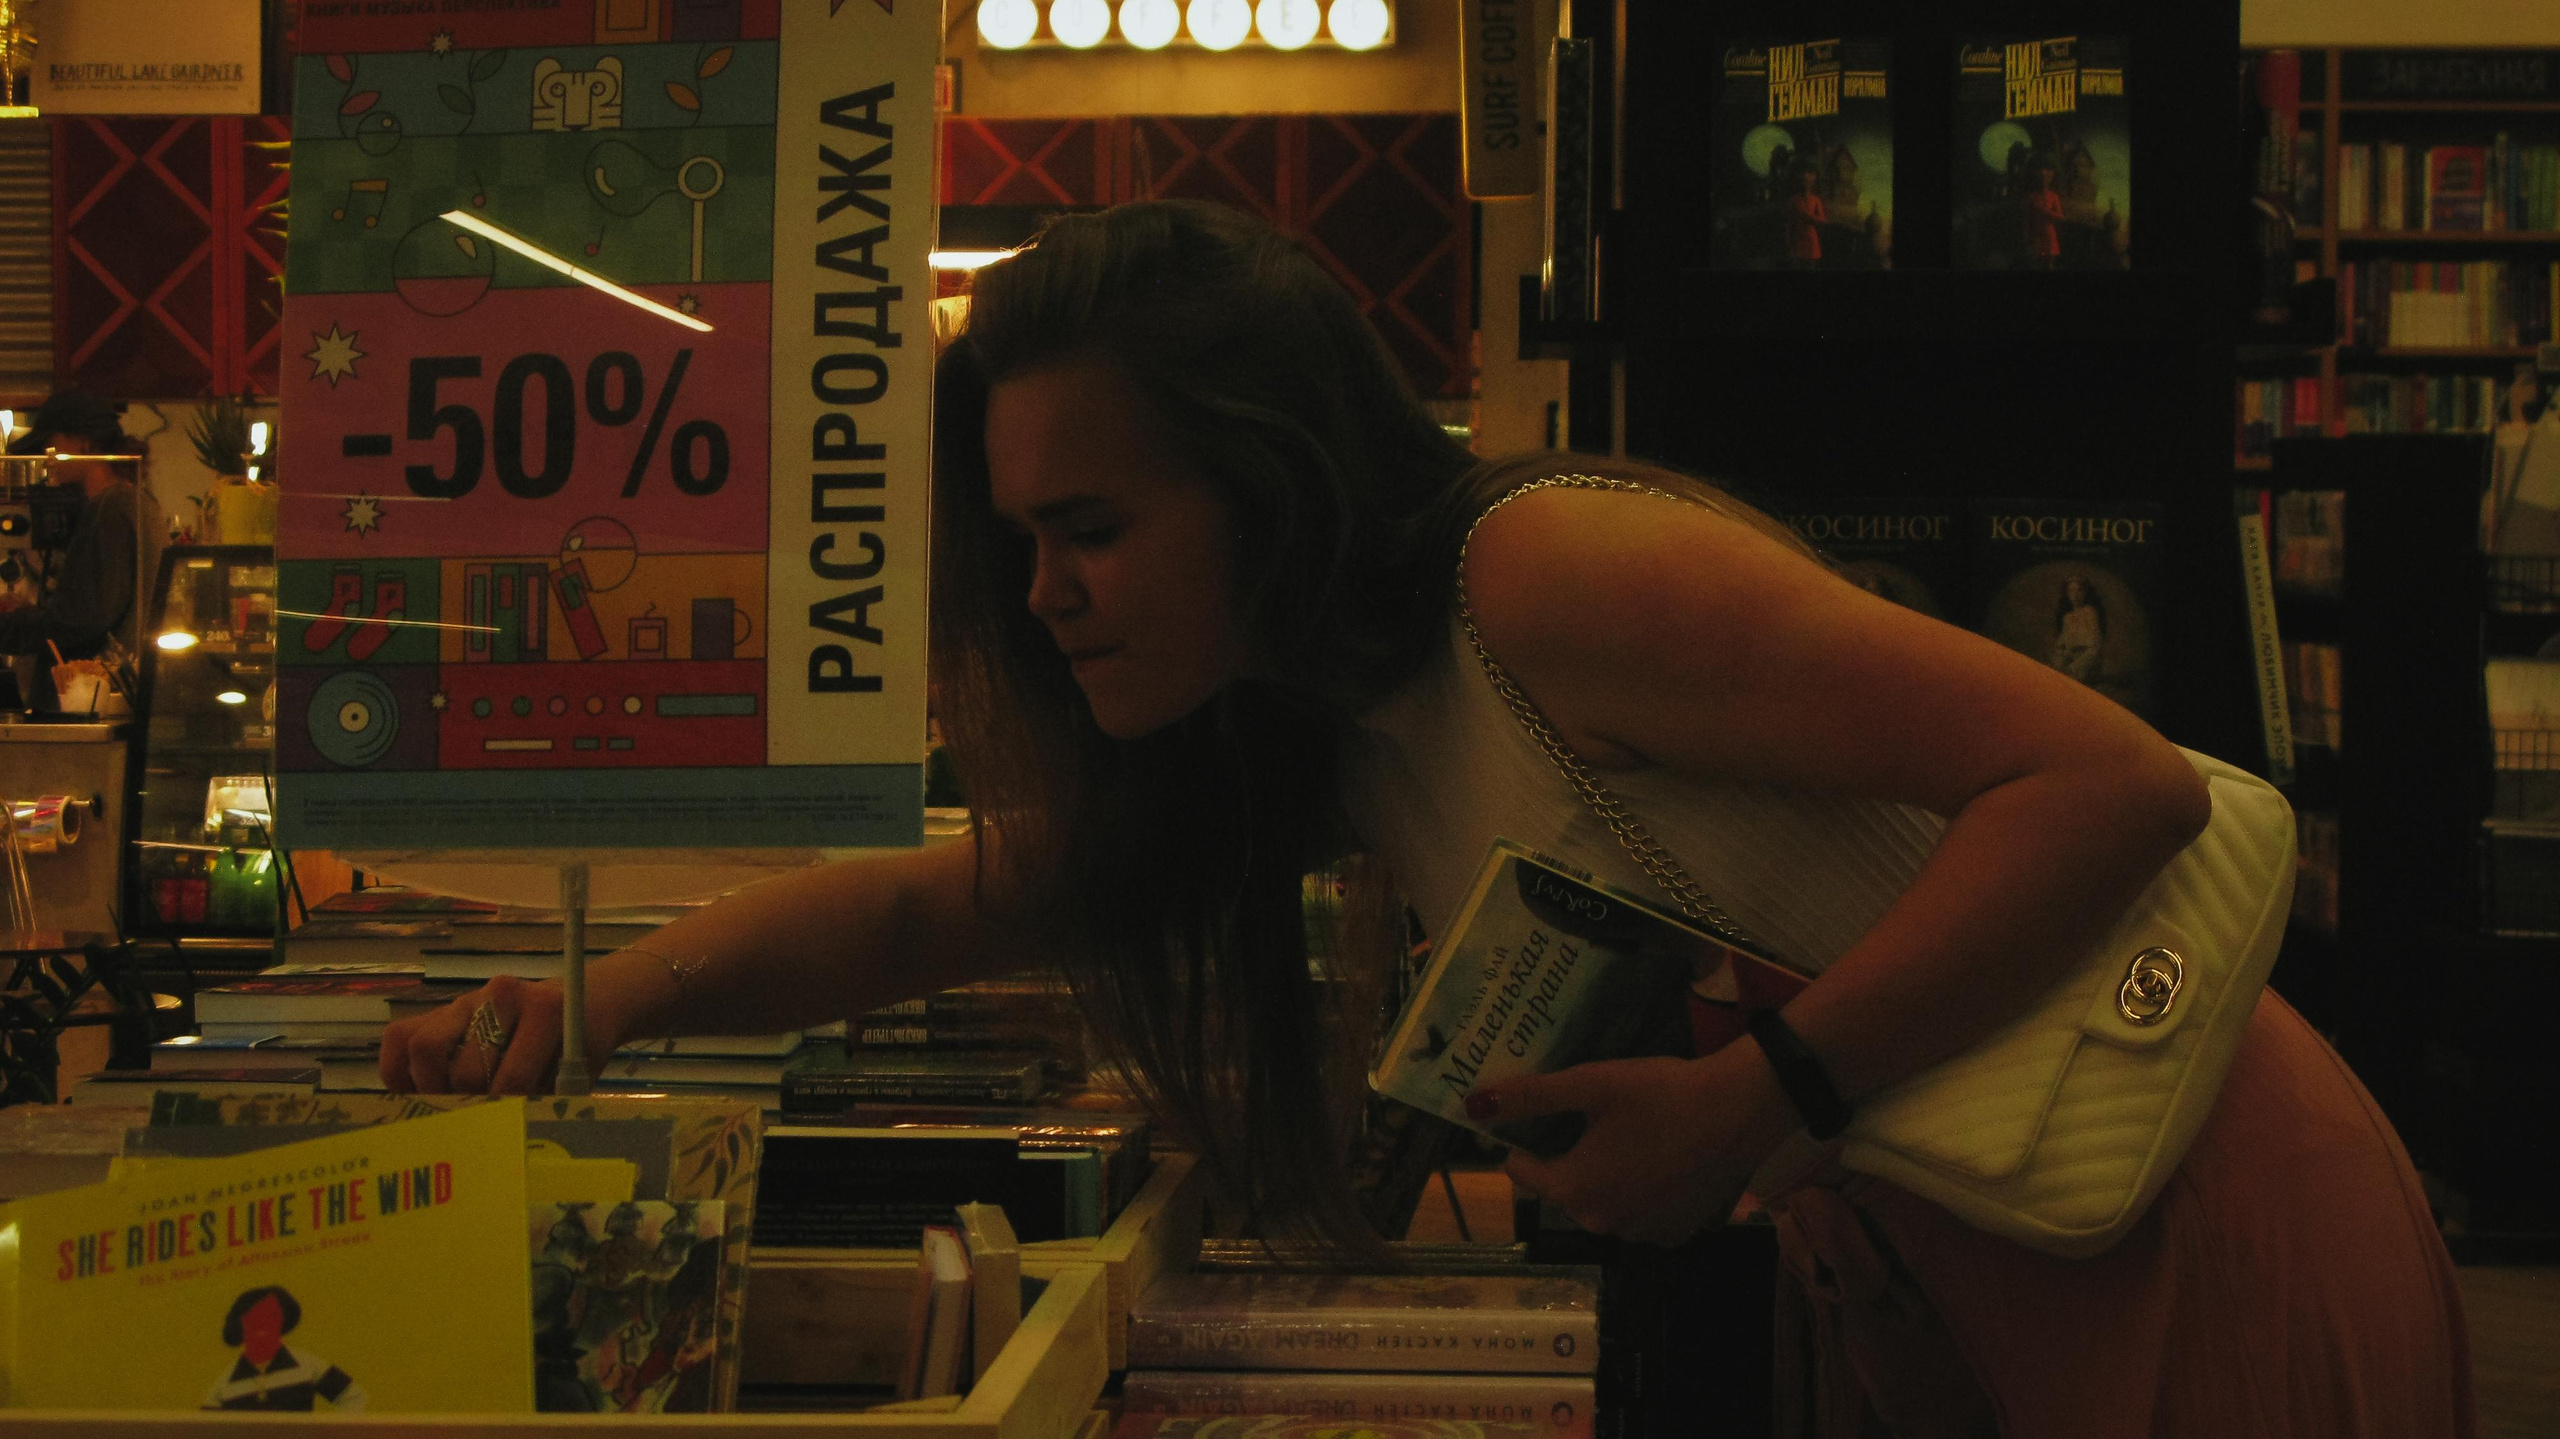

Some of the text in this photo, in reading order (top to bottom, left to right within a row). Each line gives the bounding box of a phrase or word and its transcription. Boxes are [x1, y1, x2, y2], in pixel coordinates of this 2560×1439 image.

[366, 1, 436, 15] МУЗЫКА
[50, 63, 126, 81] BEAUTIFUL
[132, 63, 167, 81] LAKE
[1768, 43, 1806, 84] НИЛ
[2005, 41, 2042, 82] НИЛ
[1483, 72, 1519, 149] SURF
[808, 82, 902, 693] РАСПРОДАЖА
[342, 348, 730, 499] -50%
[1786, 514, 1950, 541] КОСИНОГ
[1989, 514, 2154, 544] КОСИНОГ
[2261, 632, 2281, 719] ЛЮБИМЧИК
[1456, 945, 1510, 1031] ГАЭЛЬ ФАЙ
[1507, 942, 1580, 1059] страна
[1439, 929, 1550, 1100] Маленькая
[138, 1192, 198, 1216] JOAN
[57, 1162, 453, 1282] SHE RIDES LIKE THE WIND
[171, 1264, 212, 1285] Story
[218, 1257, 234, 1273] of
[1182, 1328, 1260, 1351] AGAIN
[1275, 1330, 1360, 1351] DREAM
[1375, 1334, 1534, 1350] МОНА КАСТЕН
[1272, 1397, 1356, 1419] DREAM
[1373, 1402, 1533, 1418] МОНА КАСТЕН
